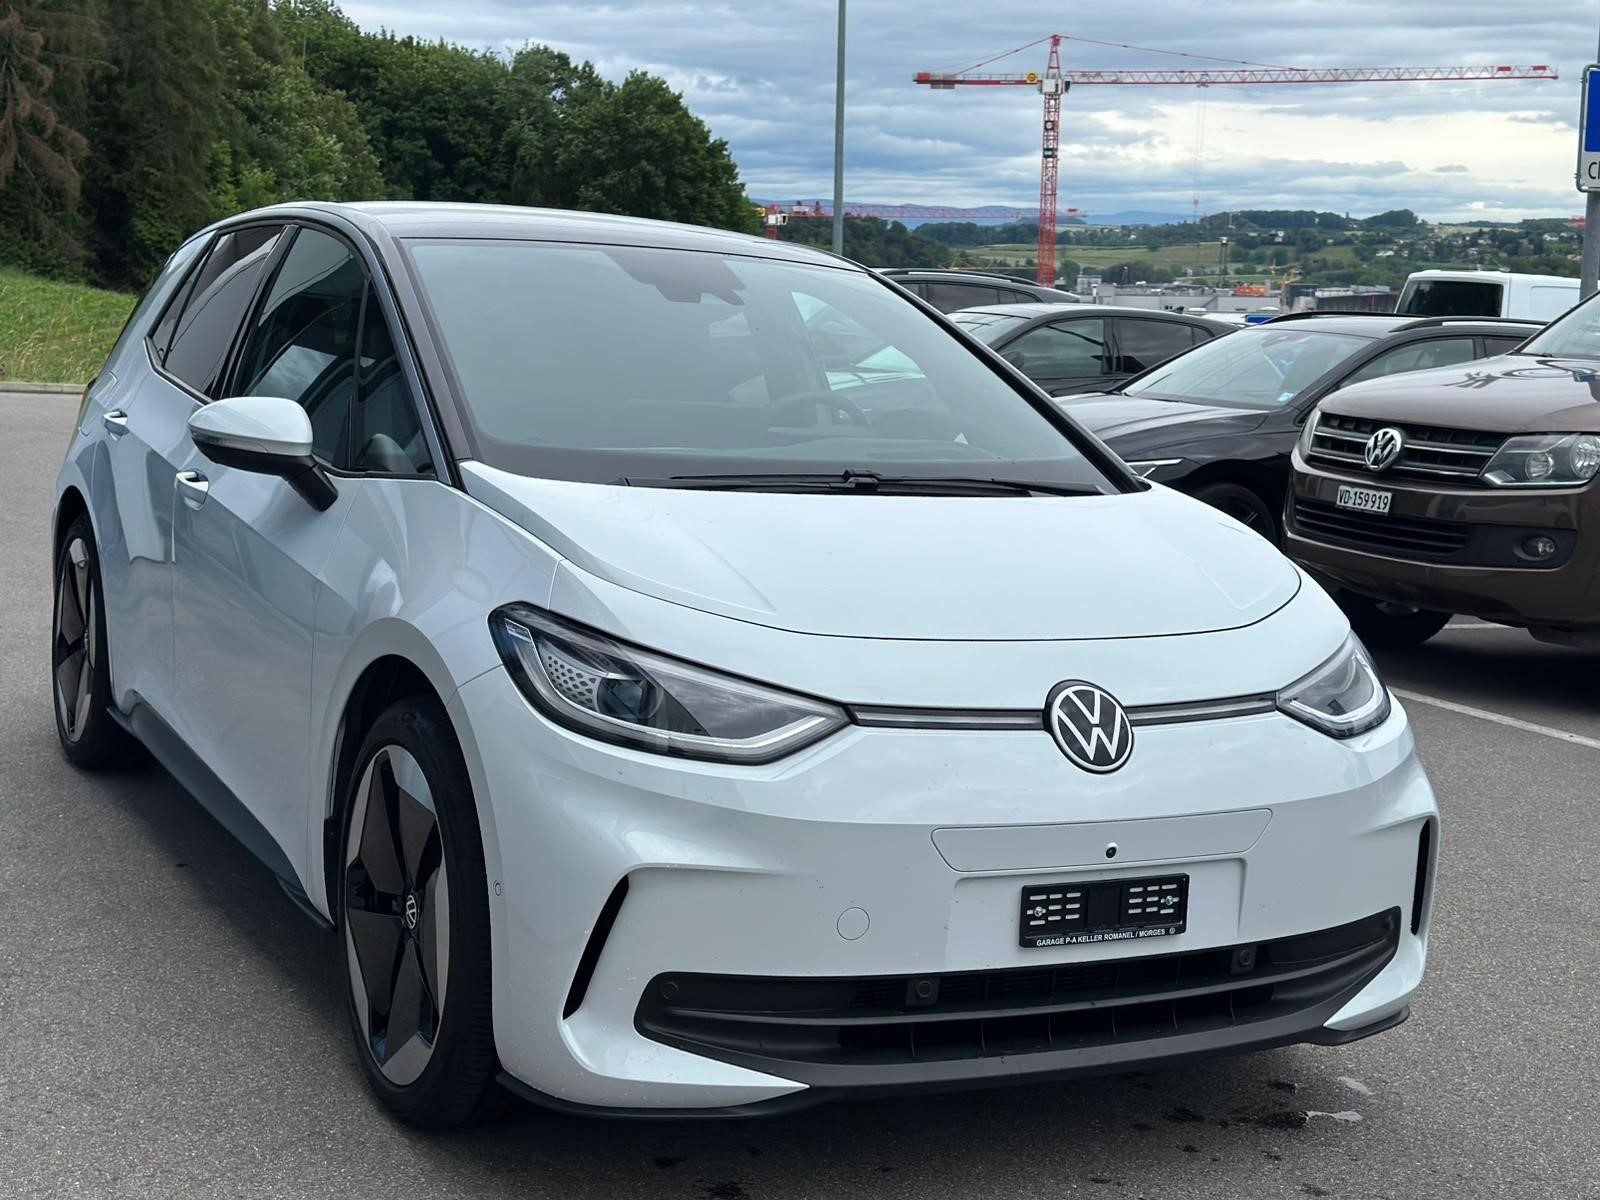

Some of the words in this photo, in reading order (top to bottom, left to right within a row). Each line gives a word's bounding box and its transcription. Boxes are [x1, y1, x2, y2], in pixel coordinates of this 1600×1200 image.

[1365, 428, 1401, 470] VW
[1051, 685, 1133, 772] VW
[1036, 937, 1065, 946] GARAGE
[1077, 934, 1103, 943] KELLER
[1103, 931, 1135, 941] ROMANEL
[1139, 928, 1166, 938] MORGES
